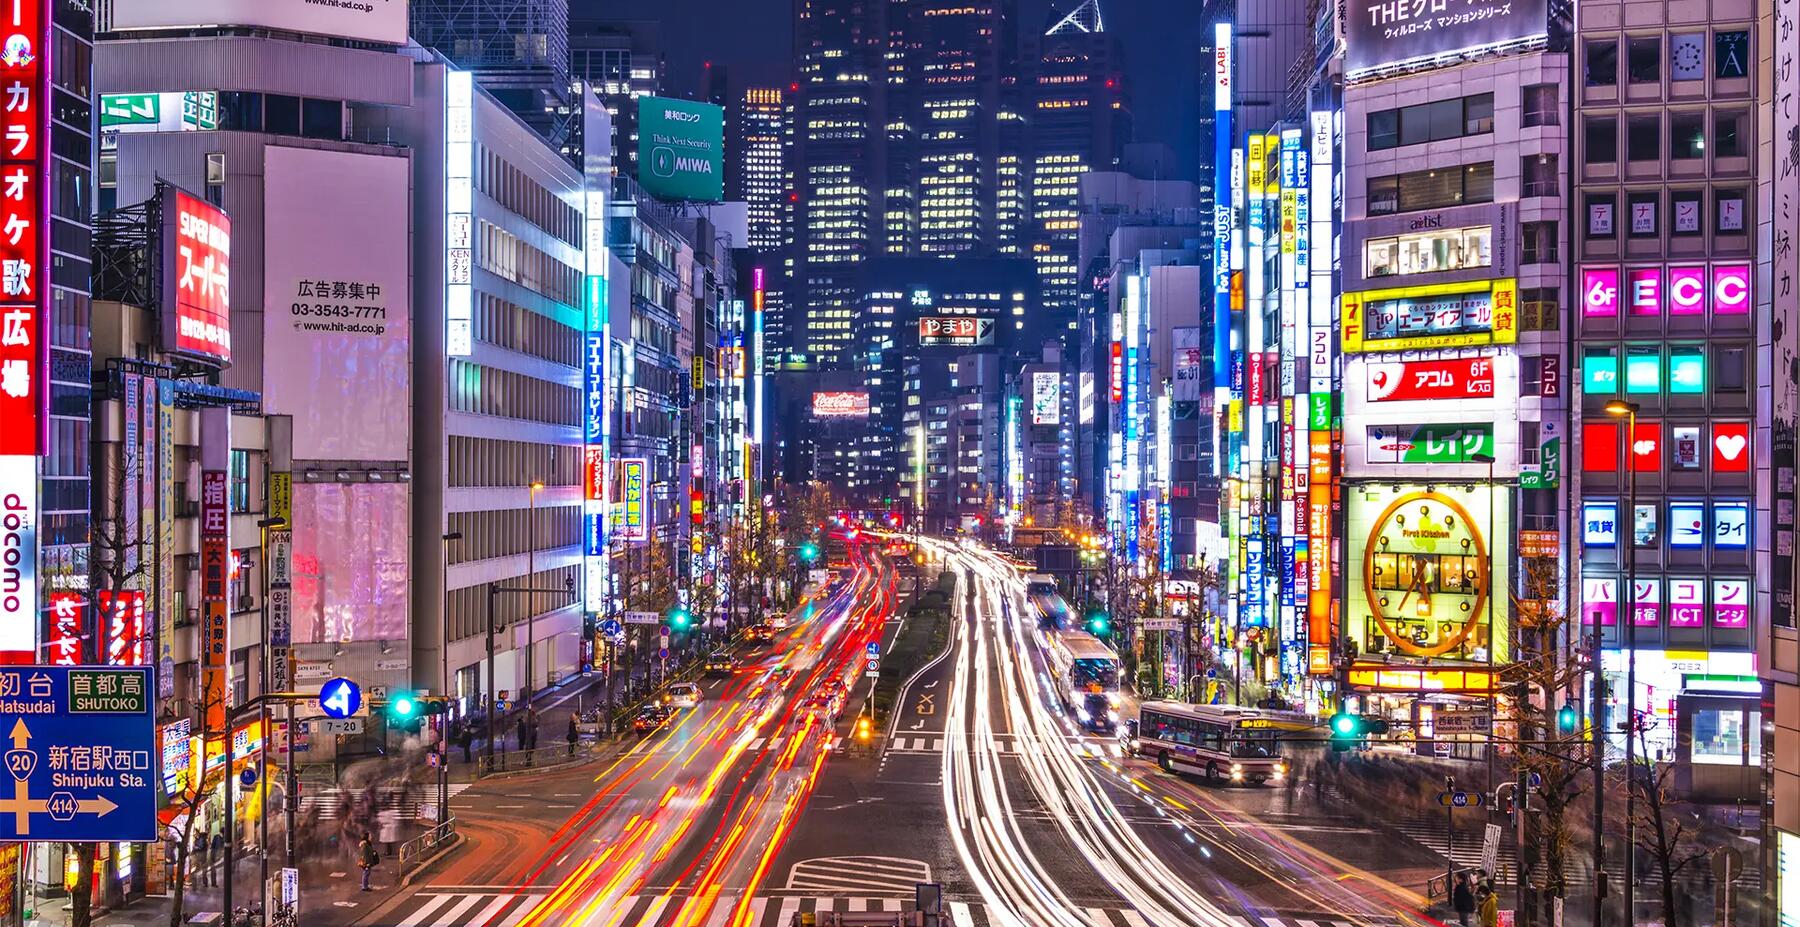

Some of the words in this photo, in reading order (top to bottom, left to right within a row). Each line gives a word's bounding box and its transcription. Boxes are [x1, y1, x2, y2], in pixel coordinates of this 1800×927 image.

[1384, 18, 1433, 39] ウィルローズ
[1437, 3, 1511, 28] マンションシリーズ
[1217, 47, 1225, 74] LABI
[1781, 0, 1793, 119] かけて
[664, 109, 700, 123] 美和ロック
[653, 133, 671, 144] Think
[672, 136, 686, 146] Next
[687, 138, 712, 151] Security
[675, 156, 712, 174] MIWA
[1283, 192, 1293, 216] 麻雀
[1595, 207, 1607, 219] テ
[1637, 205, 1649, 218] ナ
[1680, 205, 1692, 216] ン
[1726, 202, 1735, 214] ト
[1215, 204, 1230, 242] JUST
[450, 250, 470, 258] KEN
[1216, 249, 1229, 274] Your
[1779, 156, 1792, 376] ルミネカード
[298, 279, 381, 301] 広告募集中
[1216, 274, 1229, 293] For
[1587, 280, 1617, 306] 6F
[1633, 279, 1658, 306] E
[1672, 276, 1703, 306] C
[1716, 275, 1747, 305] C
[291, 303, 387, 319] 03-3543-7771
[1400, 307, 1491, 329] エーアイアール
[1494, 290, 1512, 331] 賃貸
[304, 321, 385, 335] www.hit-ad.co.jp
[925, 319, 974, 335] やまや
[1315, 332, 1326, 364] アコム
[1415, 370, 1454, 389] アコム
[1470, 362, 1489, 377] 6F
[1544, 358, 1556, 395] アコム
[1478, 380, 1491, 392] 入口
[1316, 397, 1326, 426] レイク
[1426, 429, 1484, 456] レイク
[1544, 447, 1556, 482] レイク
[1521, 475, 1539, 484] レイク
[205, 481, 225, 530] 指圧
[1296, 495, 1306, 532] le-sonia
[1311, 504, 1322, 535] First
[1403, 529, 1420, 538] First
[1421, 529, 1451, 538] Kitchen
[3, 493, 28, 612] docomo
[1311, 538, 1321, 591] Kitchen
[1248, 552, 1262, 601] ソフマップ
[1283, 547, 1293, 583] ソフマップ
[1591, 581, 1611, 600] パ
[1636, 583, 1653, 600] ソ
[1678, 584, 1695, 600] コ
[1721, 584, 1741, 601] ン
[1672, 608, 1702, 622] ICT
[1716, 609, 1745, 623] ビジ
[0, 673, 54, 697] 初台
[72, 674, 142, 696] 首都高
[76, 698, 139, 711] SHUTOKO
[327, 722, 357, 732] 7-20
[11, 754, 32, 772] 20
[48, 745, 150, 772] 新宿駅西口
[52, 773, 114, 790] Shinjuku
[119, 773, 147, 788] Sta.
[51, 800, 74, 814] 414
